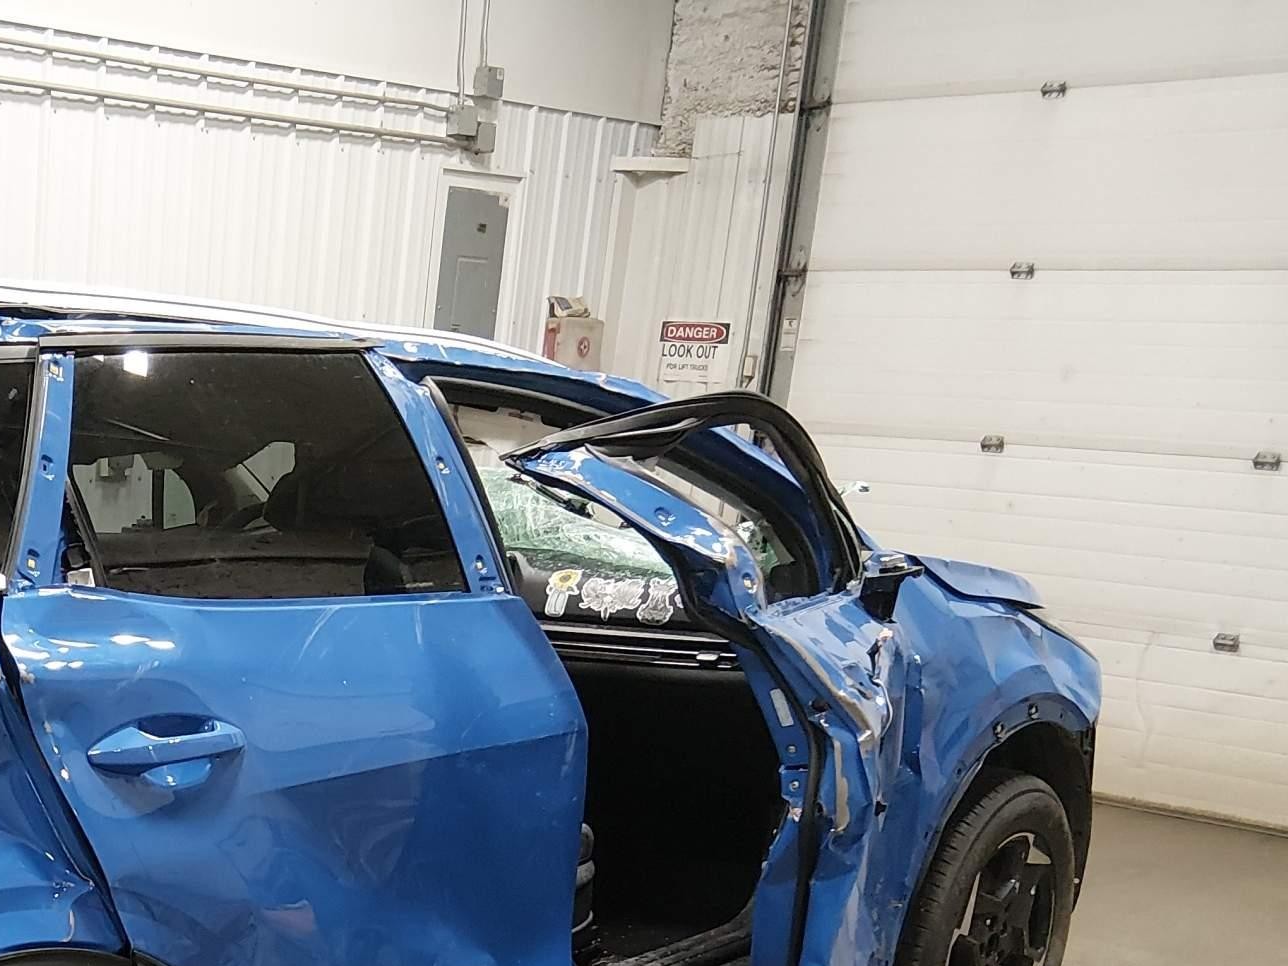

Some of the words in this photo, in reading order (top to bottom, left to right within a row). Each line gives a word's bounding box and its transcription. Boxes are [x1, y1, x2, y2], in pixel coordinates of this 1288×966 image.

[667, 326, 718, 339] DANGER
[662, 343, 694, 358] LOOK
[696, 344, 718, 359] OUT
